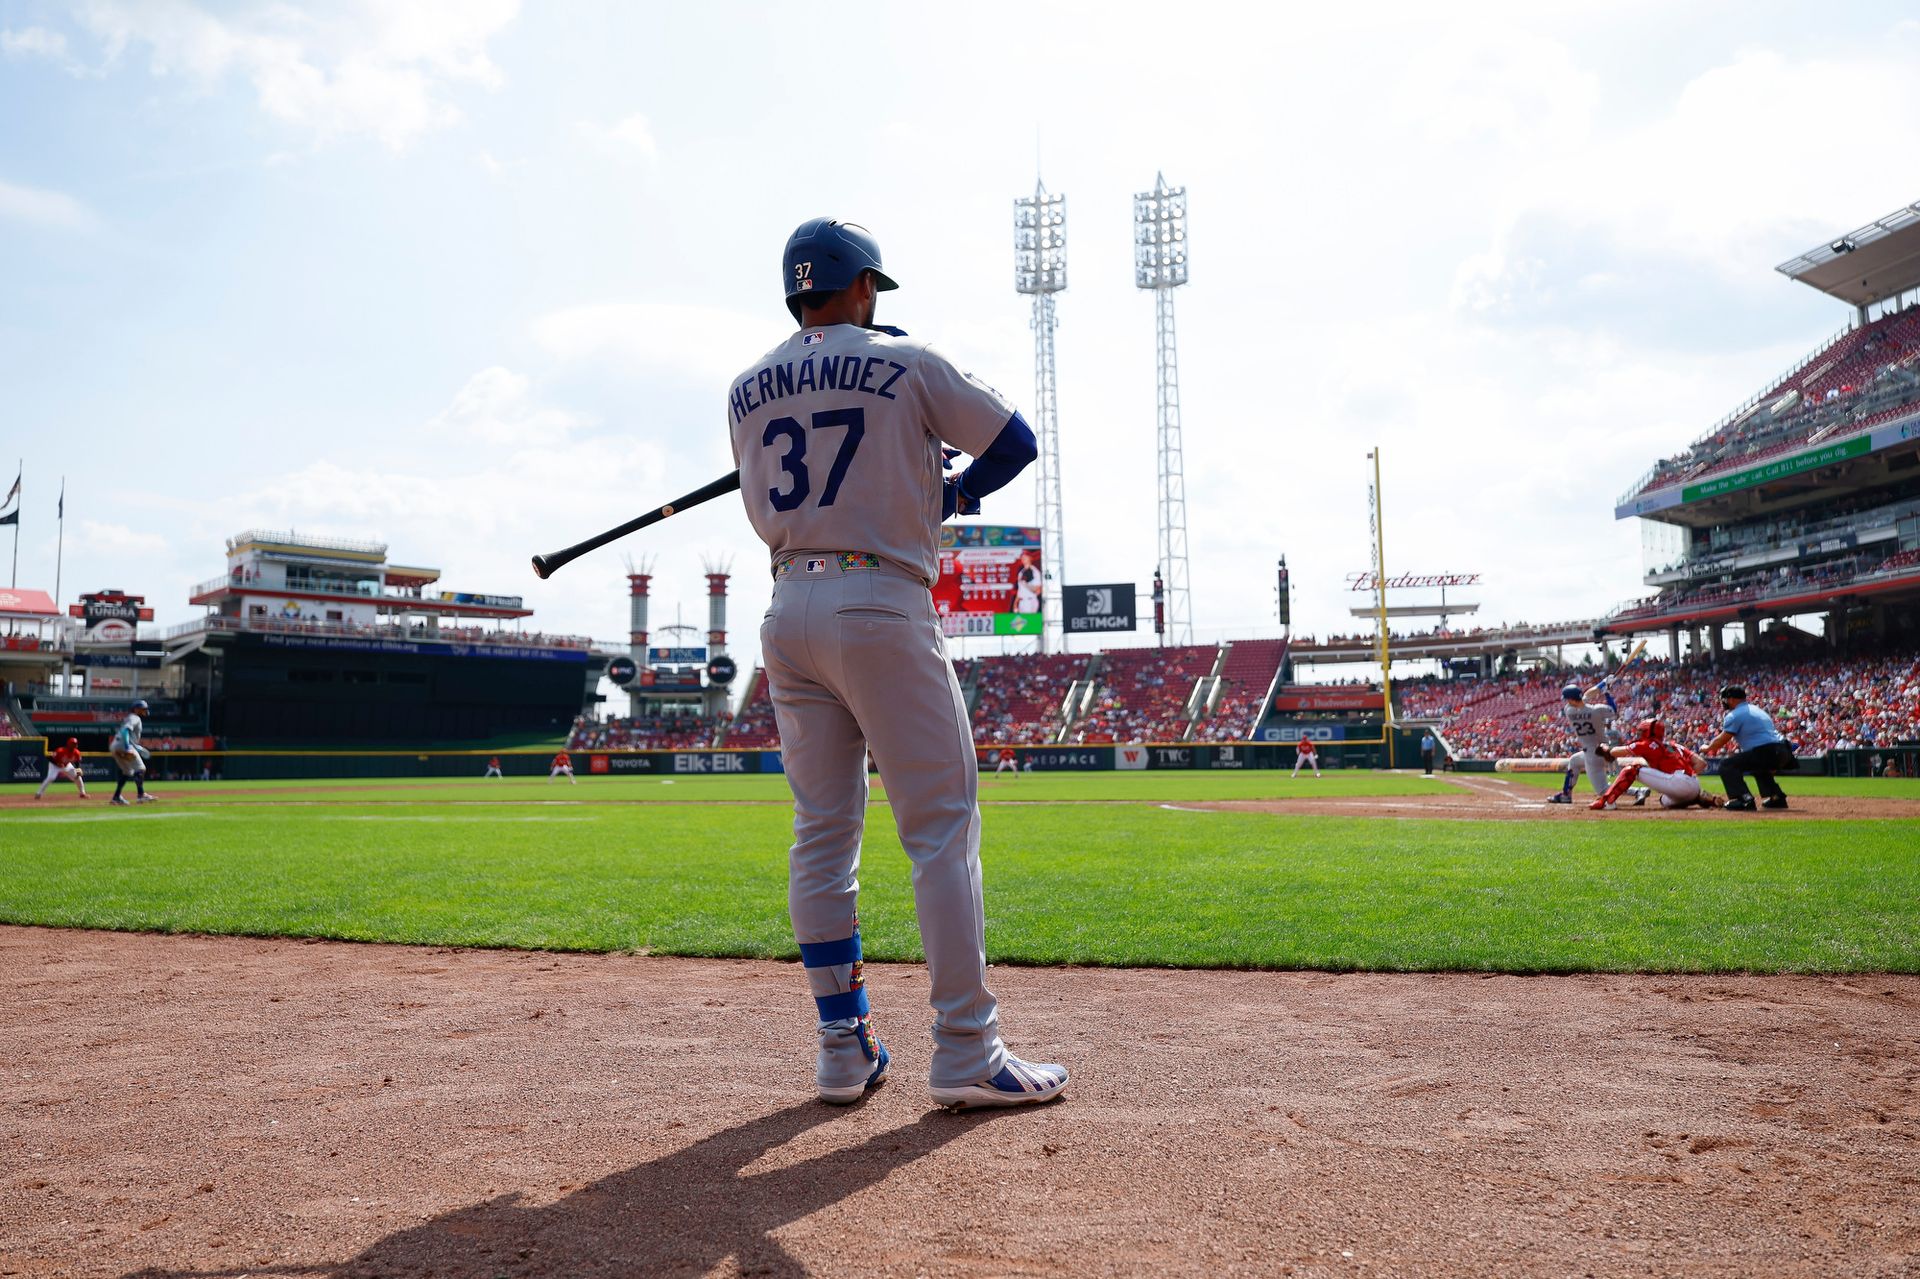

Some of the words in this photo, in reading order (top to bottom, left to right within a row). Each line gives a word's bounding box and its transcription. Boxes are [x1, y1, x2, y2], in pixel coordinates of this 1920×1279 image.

[795, 262, 811, 279] 37
[731, 351, 907, 424] HERNÁNDEZ
[763, 407, 865, 512] 37
[1766, 467, 1779, 476] Call
[1781, 463, 1793, 472] 811
[1796, 457, 1818, 470] before
[1819, 452, 1833, 462] you
[88, 607, 136, 617] TUNDRA
[1071, 616, 1129, 629] BETMGM
[263, 634, 285, 644] Find
[328, 638, 371, 648] adventure
[1314, 698, 1364, 708] Budweiser
[1264, 727, 1332, 740] GEICO
[1573, 721, 1596, 736] 23
[1123, 751, 1140, 762] W
[1156, 749, 1190, 762] TWC
[611, 759, 651, 768] TOYOTA
